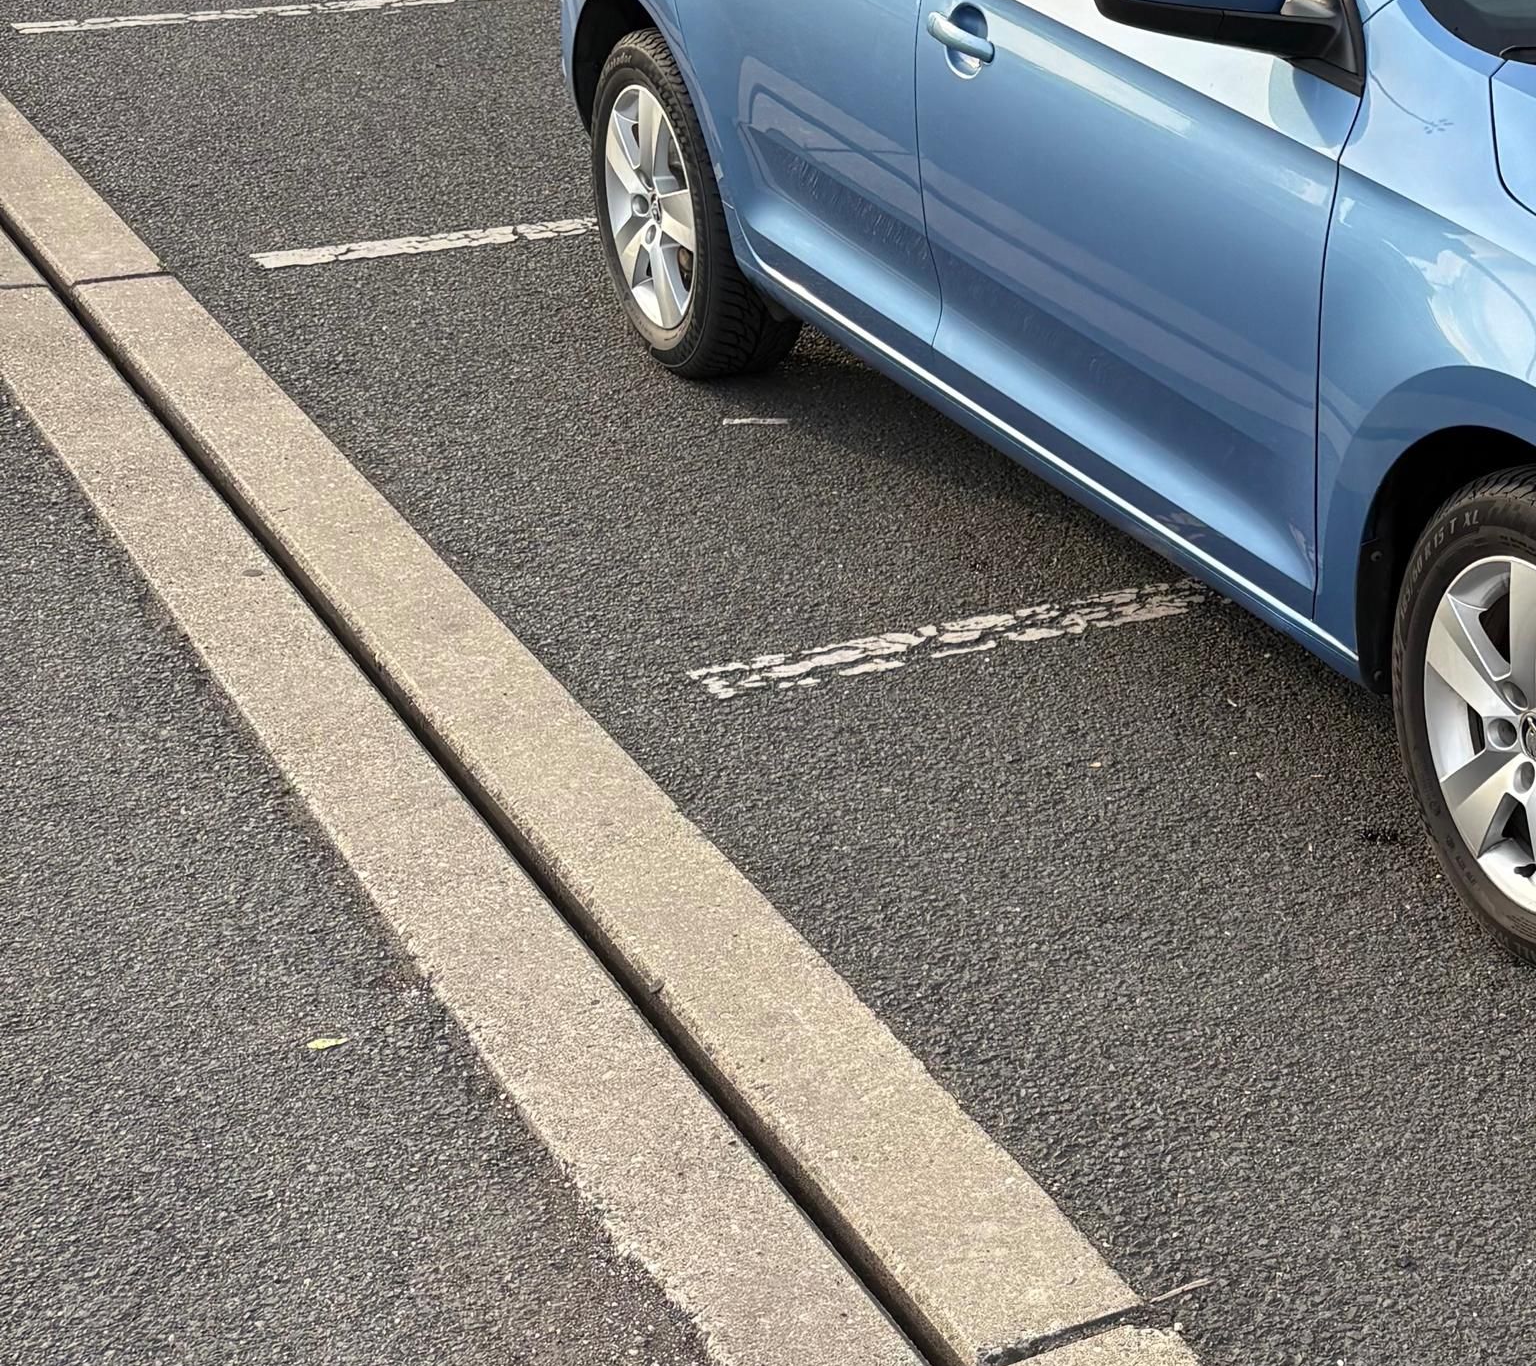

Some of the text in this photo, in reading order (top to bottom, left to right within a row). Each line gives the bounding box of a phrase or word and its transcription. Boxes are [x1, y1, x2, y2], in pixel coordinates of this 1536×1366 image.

[1425, 541, 1431, 561] R
[1433, 526, 1444, 548] 15
[1449, 517, 1457, 535] T
[1463, 510, 1479, 528] XL
